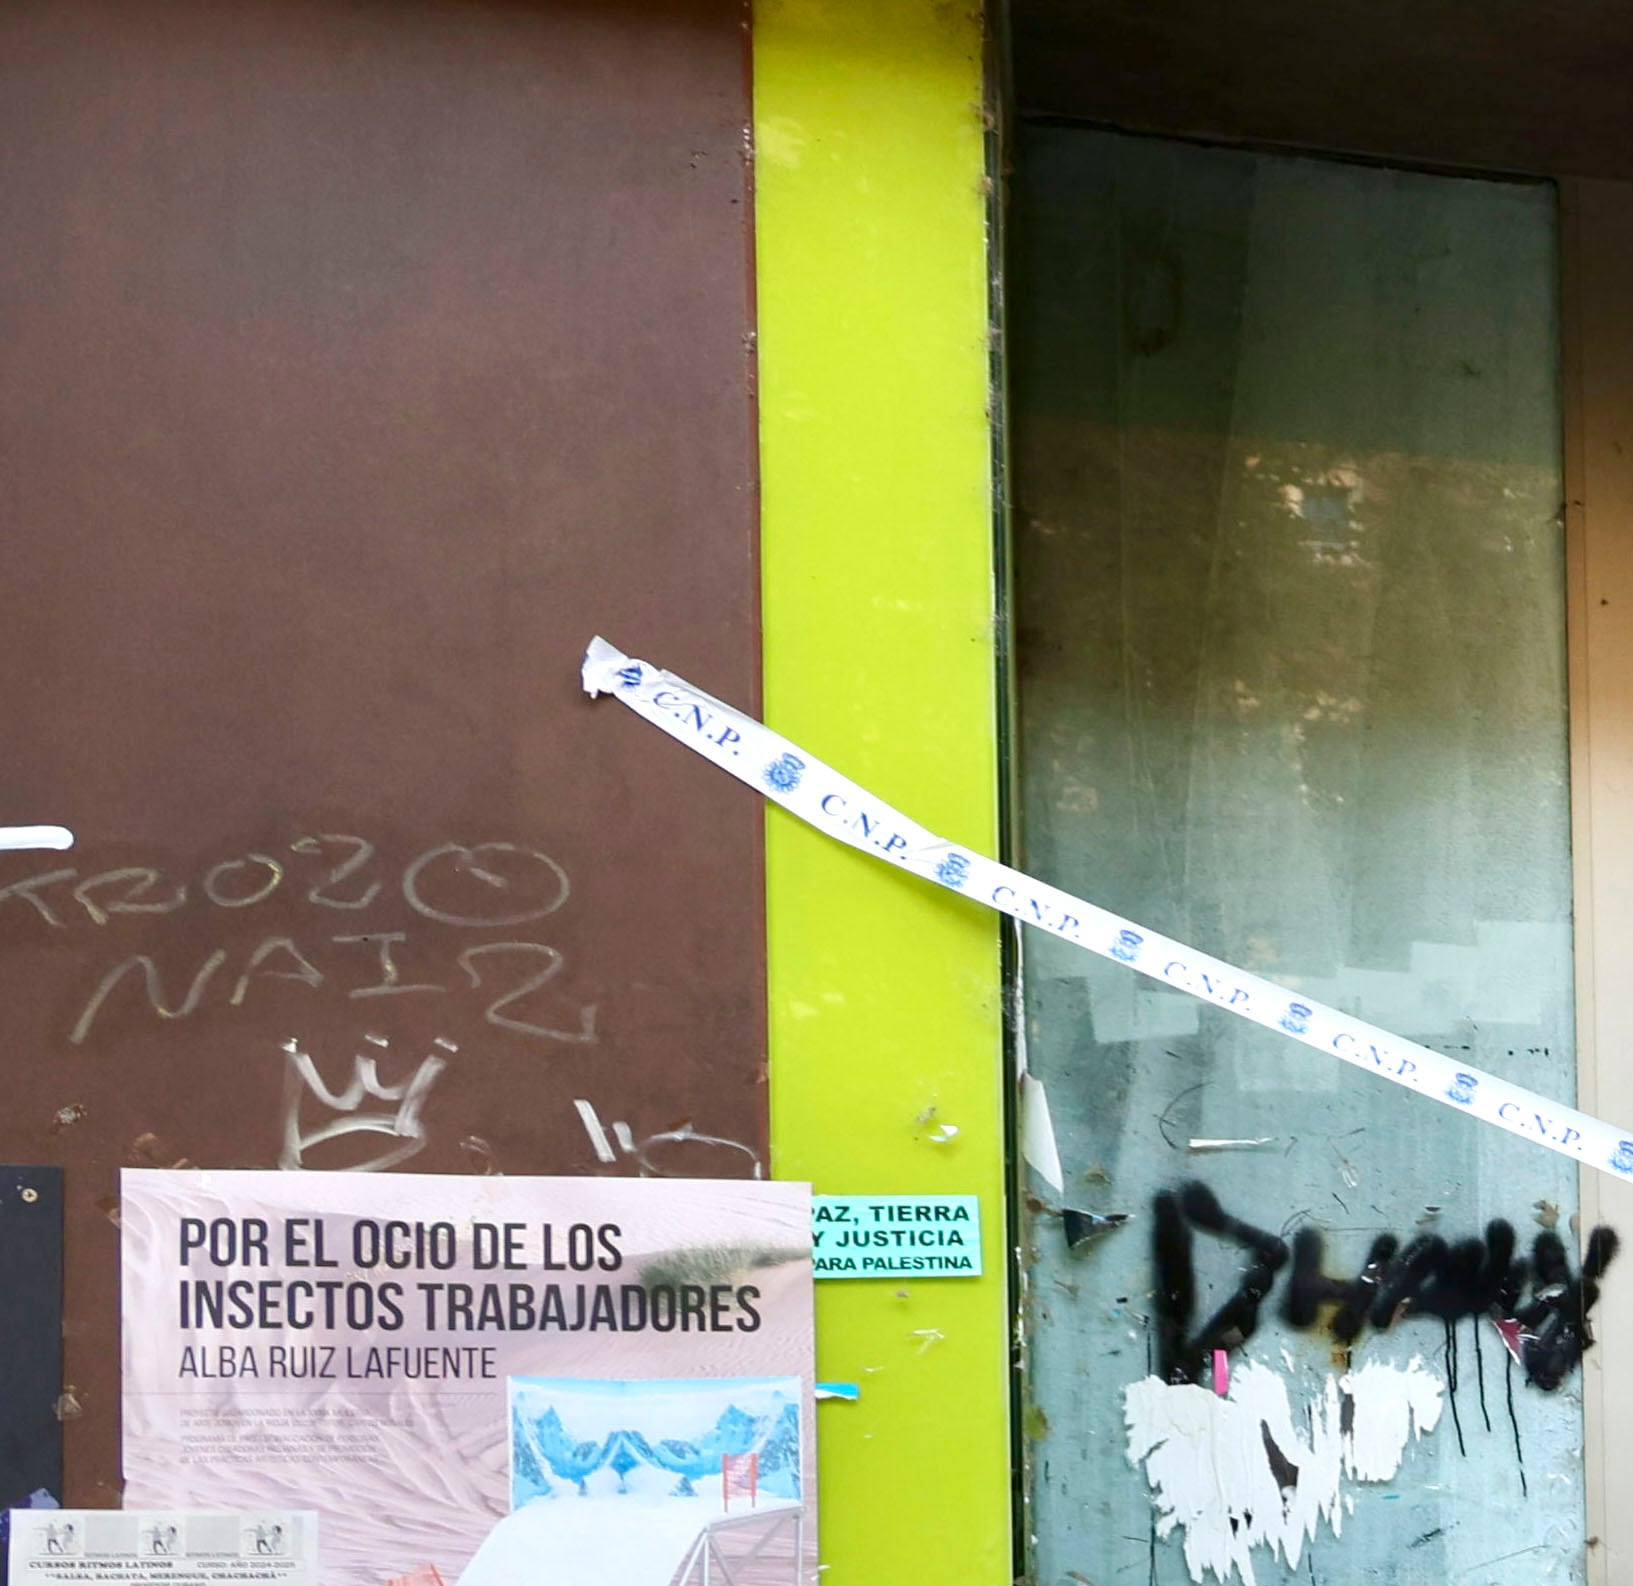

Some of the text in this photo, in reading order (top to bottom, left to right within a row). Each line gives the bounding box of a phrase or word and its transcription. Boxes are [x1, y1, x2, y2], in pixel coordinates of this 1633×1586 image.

[652, 682, 741, 756] C.N.P.
[820, 793, 908, 860] C.N.P.
[991, 885, 1081, 949] C.N.P.
[1162, 961, 1249, 1005] C.N.P.
[1332, 1033, 1418, 1091] C.N.P.
[1497, 1103, 1582, 1151] C.N.P.
[812, 1205, 970, 1226] AZ, TIERRA
[179, 1218, 623, 1272] POR EL OCIO DE LOS
[812, 1230, 964, 1247] Y JUSTICIA
[812, 1256, 973, 1271] ARA PALESTINA
[179, 1280, 762, 1332] INSECTOS TRABAJADORES
[179, 1346, 497, 1379] ALBA RUIZ LAFUENTE
[29, 1561, 76, 1569] CURSOS
[79, 1561, 122, 1569] RITMOS
